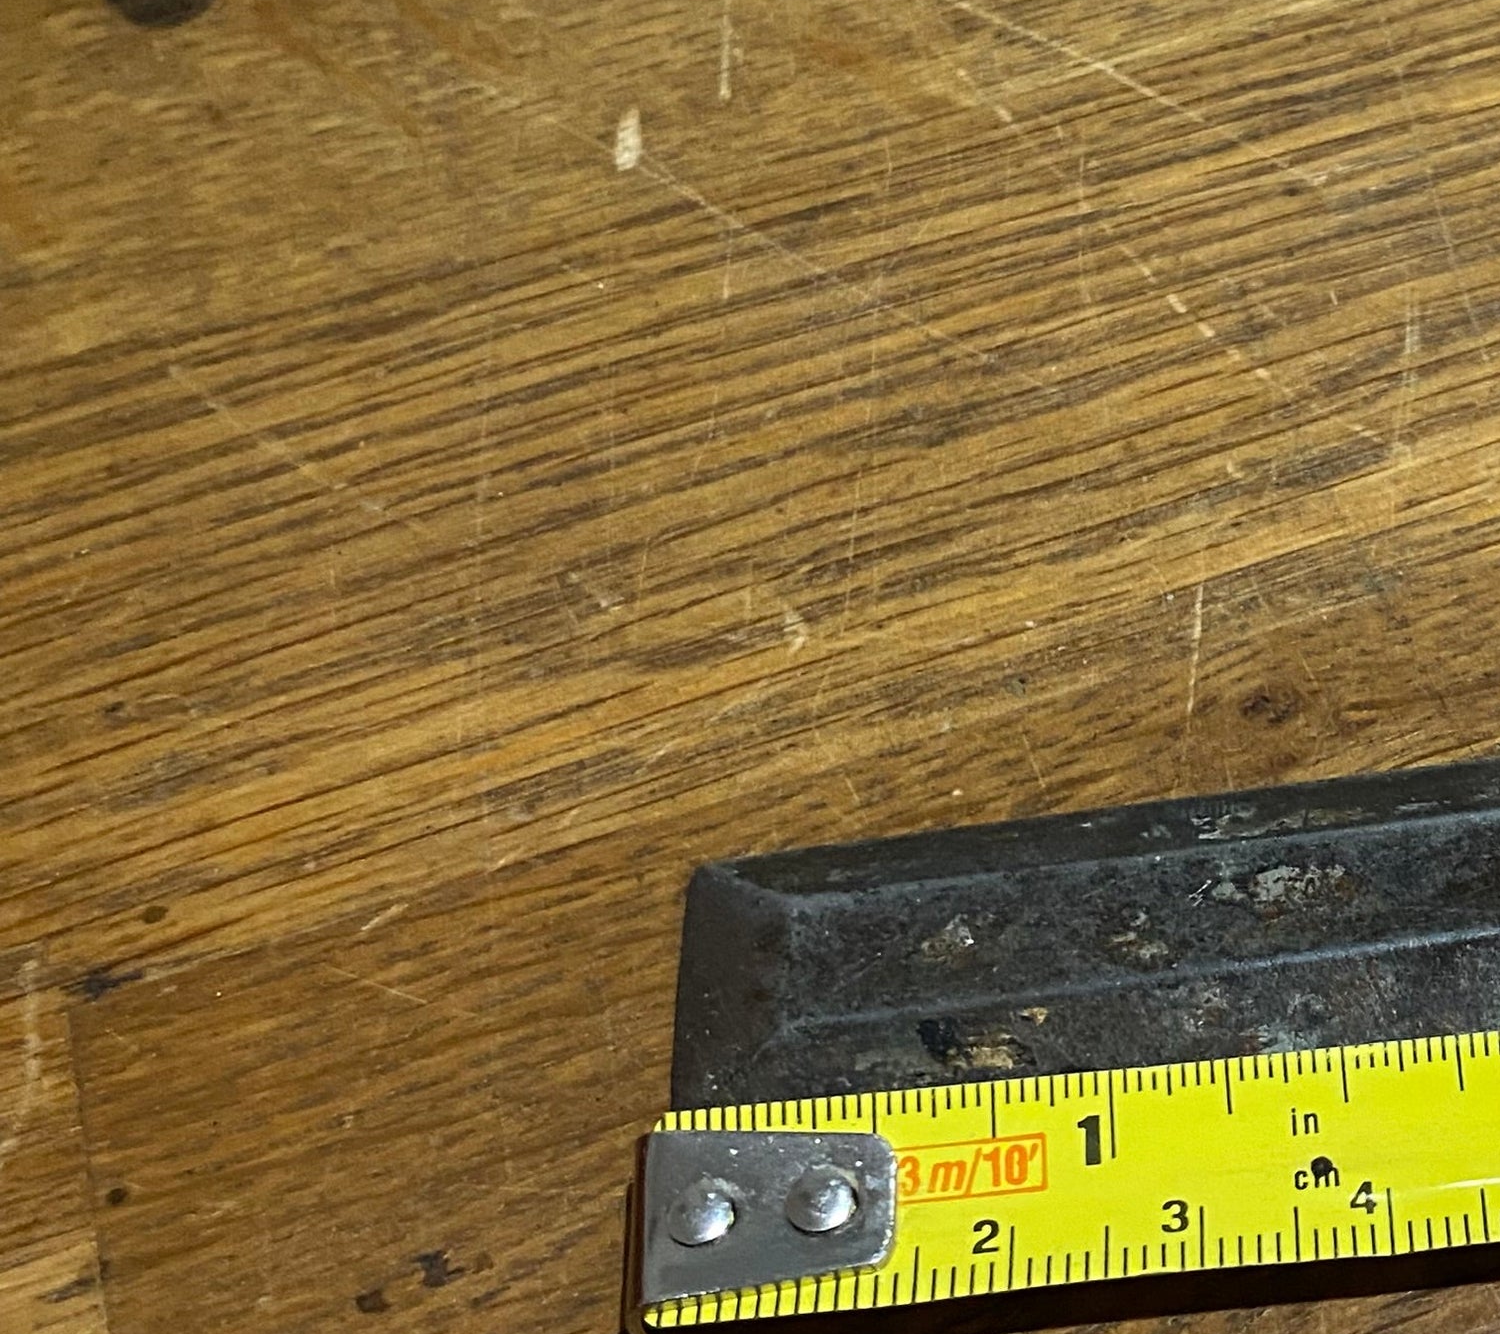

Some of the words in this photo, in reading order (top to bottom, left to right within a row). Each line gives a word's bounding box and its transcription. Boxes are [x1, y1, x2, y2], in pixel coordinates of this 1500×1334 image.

[1290, 1107, 1319, 1137] in
[1076, 1114, 1101, 1166] 1
[1350, 1182, 1378, 1214] 4
[1161, 1199, 1189, 1234] 3
[972, 1219, 1000, 1254] 2
